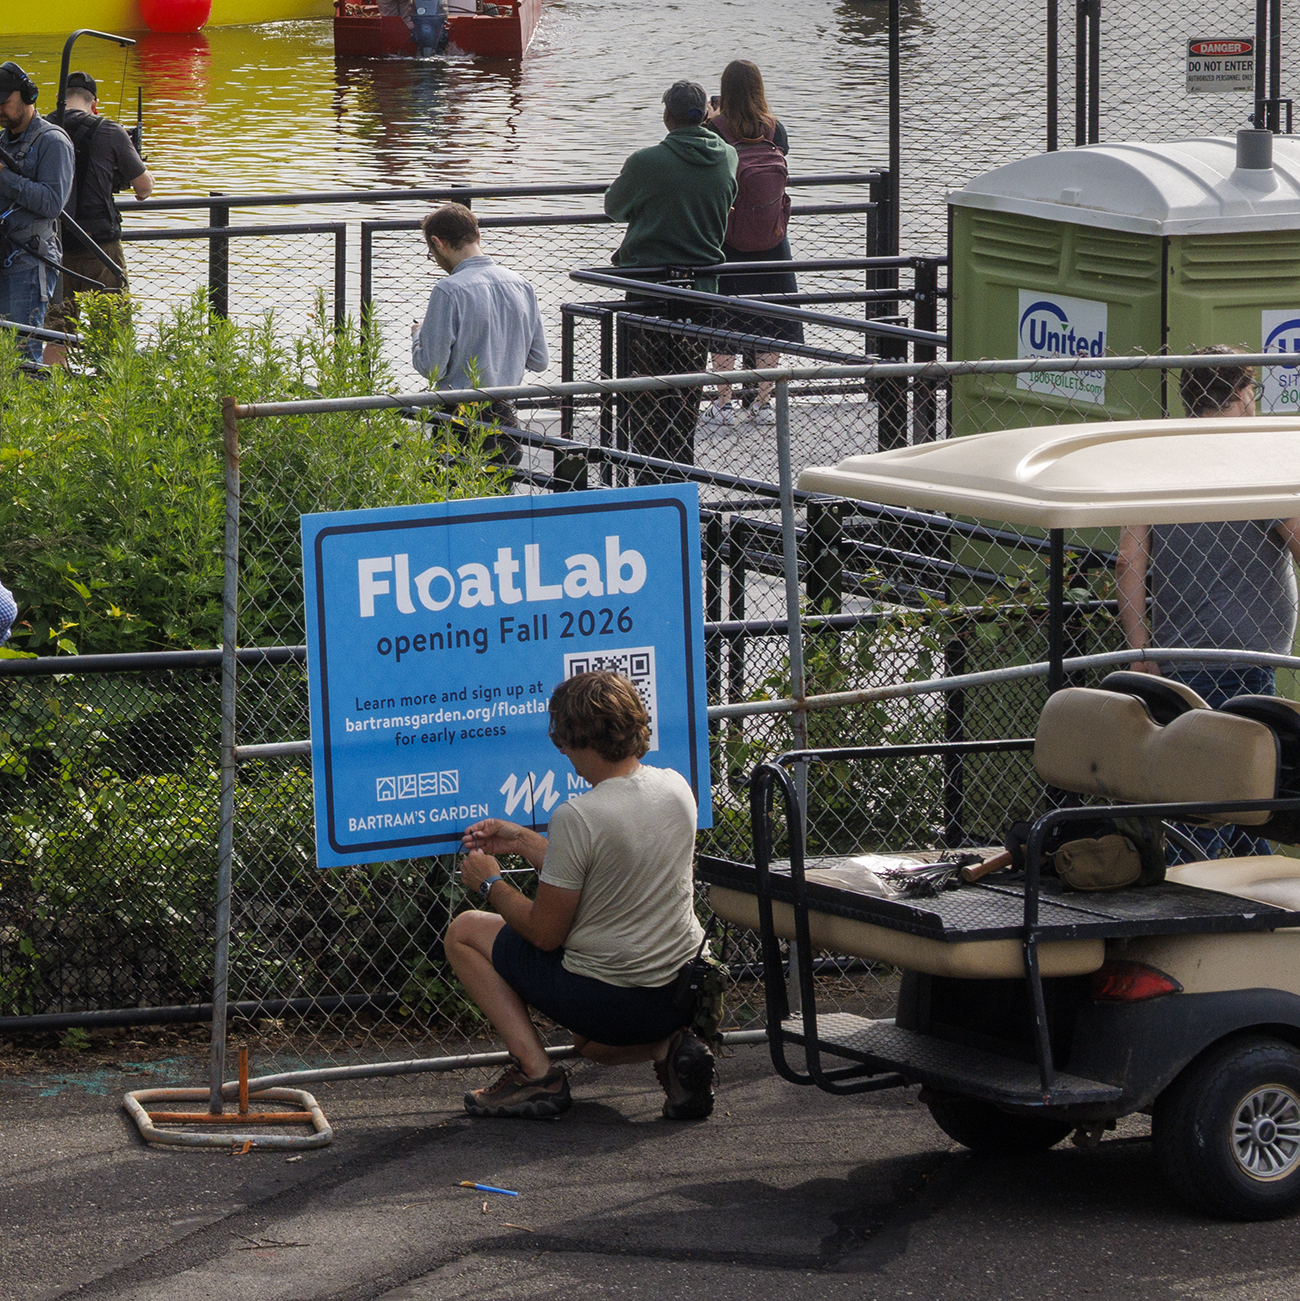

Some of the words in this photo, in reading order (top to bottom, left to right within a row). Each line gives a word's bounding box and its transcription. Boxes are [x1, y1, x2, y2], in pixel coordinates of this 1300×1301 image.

[1200, 43, 1242, 53] DANGER
[1188, 61, 1201, 72] DO
[1204, 61, 1222, 72] NOT
[1225, 60, 1254, 71] ENTER
[1029, 318, 1104, 358] United
[358, 535, 648, 618] FloatLab
[376, 622, 488, 663] opening
[500, 613, 548, 644] Fall
[559, 605, 634, 639] 2026
[355, 697, 396, 712] Learn
[400, 694, 437, 707] more
[441, 687, 467, 702] and
[472, 685, 501, 702] sign
[506, 685, 524, 699] up
[529, 681, 543, 694] at
[395, 732, 416, 746] for
[421, 727, 455, 745] early
[460, 725, 507, 740] access
[429, 803, 490, 823] GARDEN
